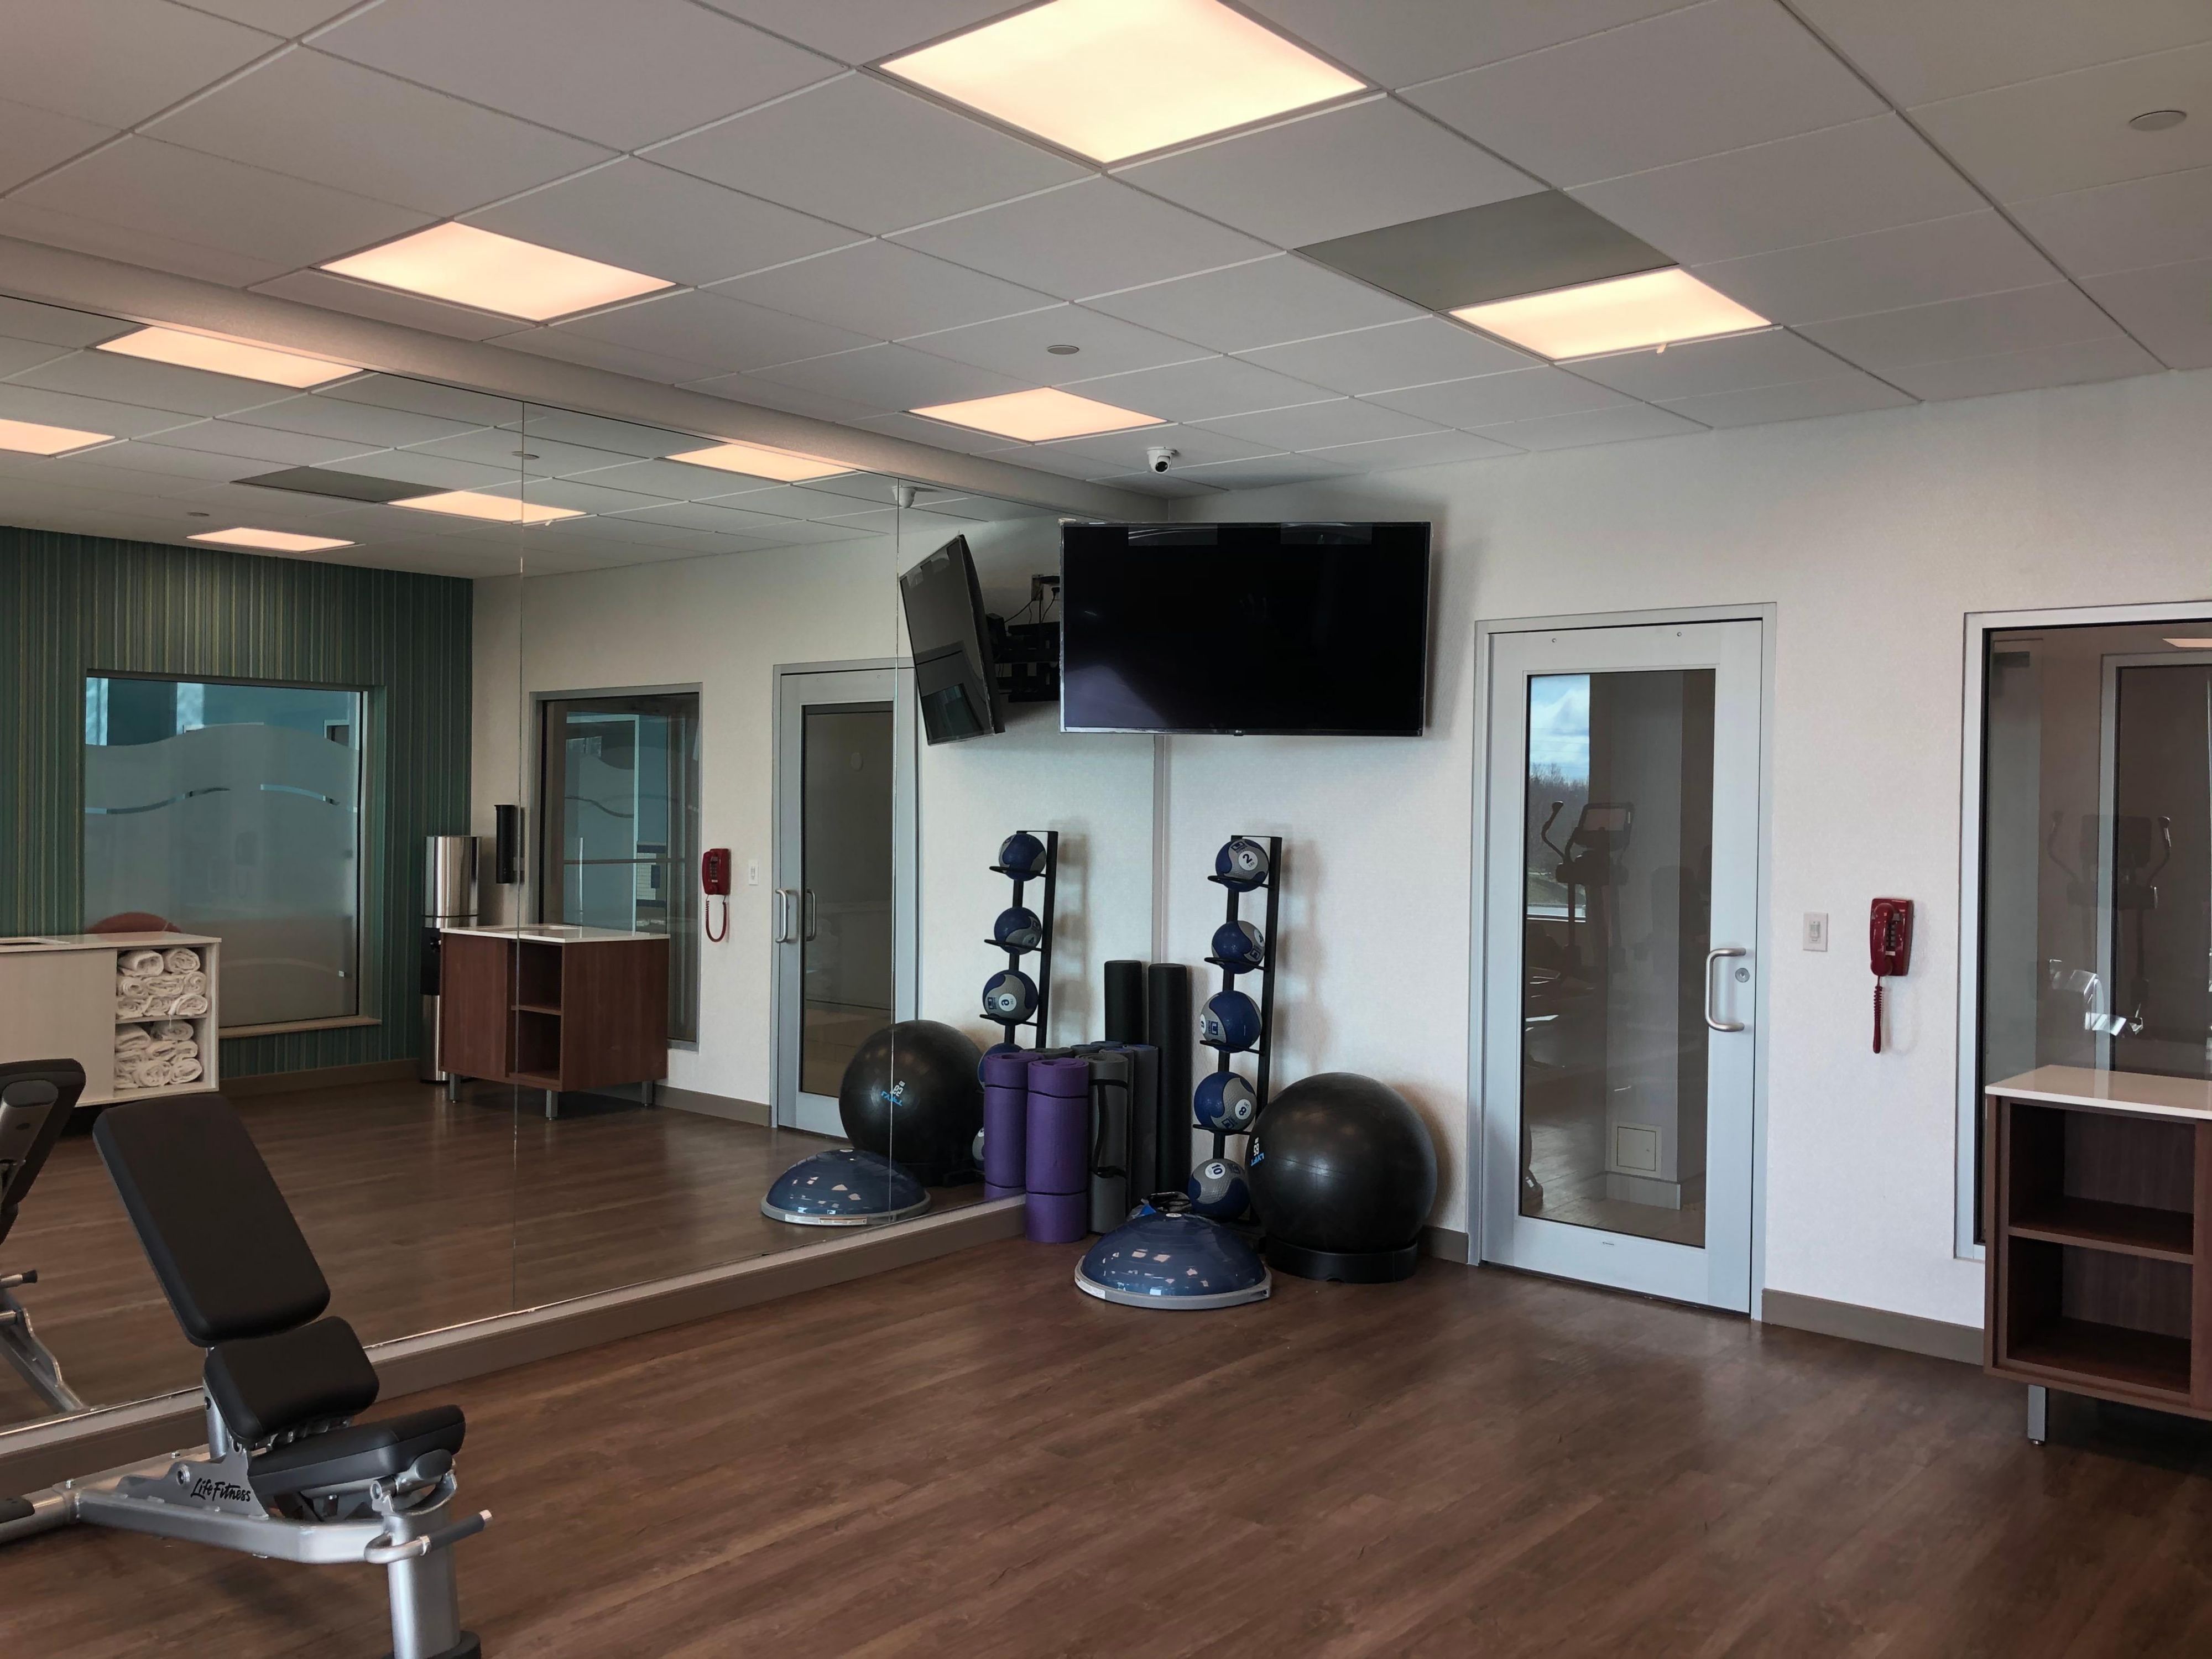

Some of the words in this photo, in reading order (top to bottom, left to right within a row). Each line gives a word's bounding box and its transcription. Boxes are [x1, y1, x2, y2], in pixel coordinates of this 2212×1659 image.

[1243, 854, 1253, 864] 2
[1239, 1107, 1246, 1116] 8
[1251, 1152, 1264, 1166] LYFT
[1212, 1164, 1223, 1175] 10
[190, 1478, 213, 1500] Life
[212, 1481, 251, 1502] Fitness
